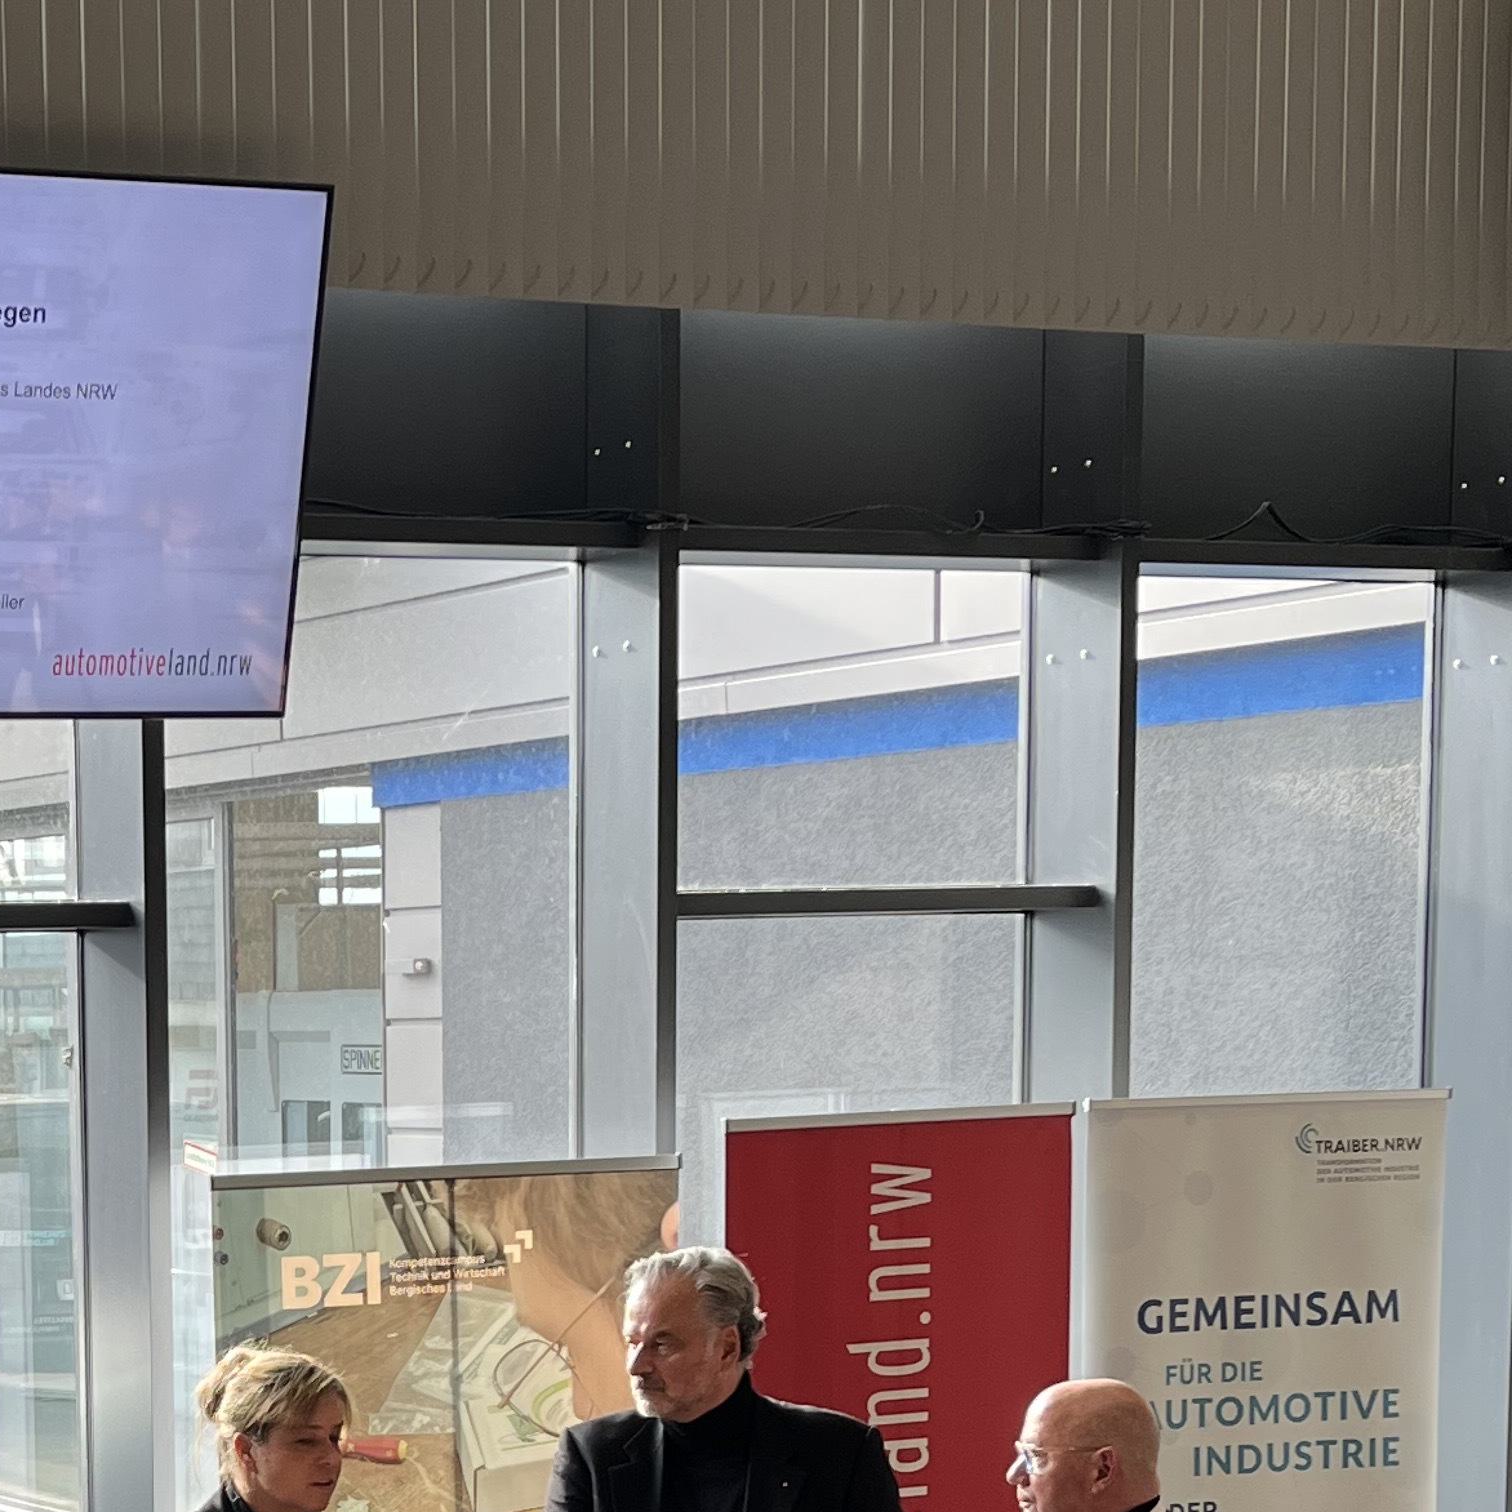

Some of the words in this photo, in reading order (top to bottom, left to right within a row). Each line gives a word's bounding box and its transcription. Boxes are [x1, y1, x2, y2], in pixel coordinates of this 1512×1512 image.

[14, 382, 70, 399] Landes
[76, 383, 118, 400] NRW
[52, 647, 252, 677] automotiveland.nrw
[1315, 1137, 1422, 1154] TRAIBER.NRW
[281, 1251, 381, 1310] BZI
[1137, 1289, 1400, 1335] GEMEINSAM
[1165, 1357, 1213, 1386] FÜR
[1221, 1360, 1263, 1382] DIE
[1193, 1436, 1400, 1477] INDUSTRIE
